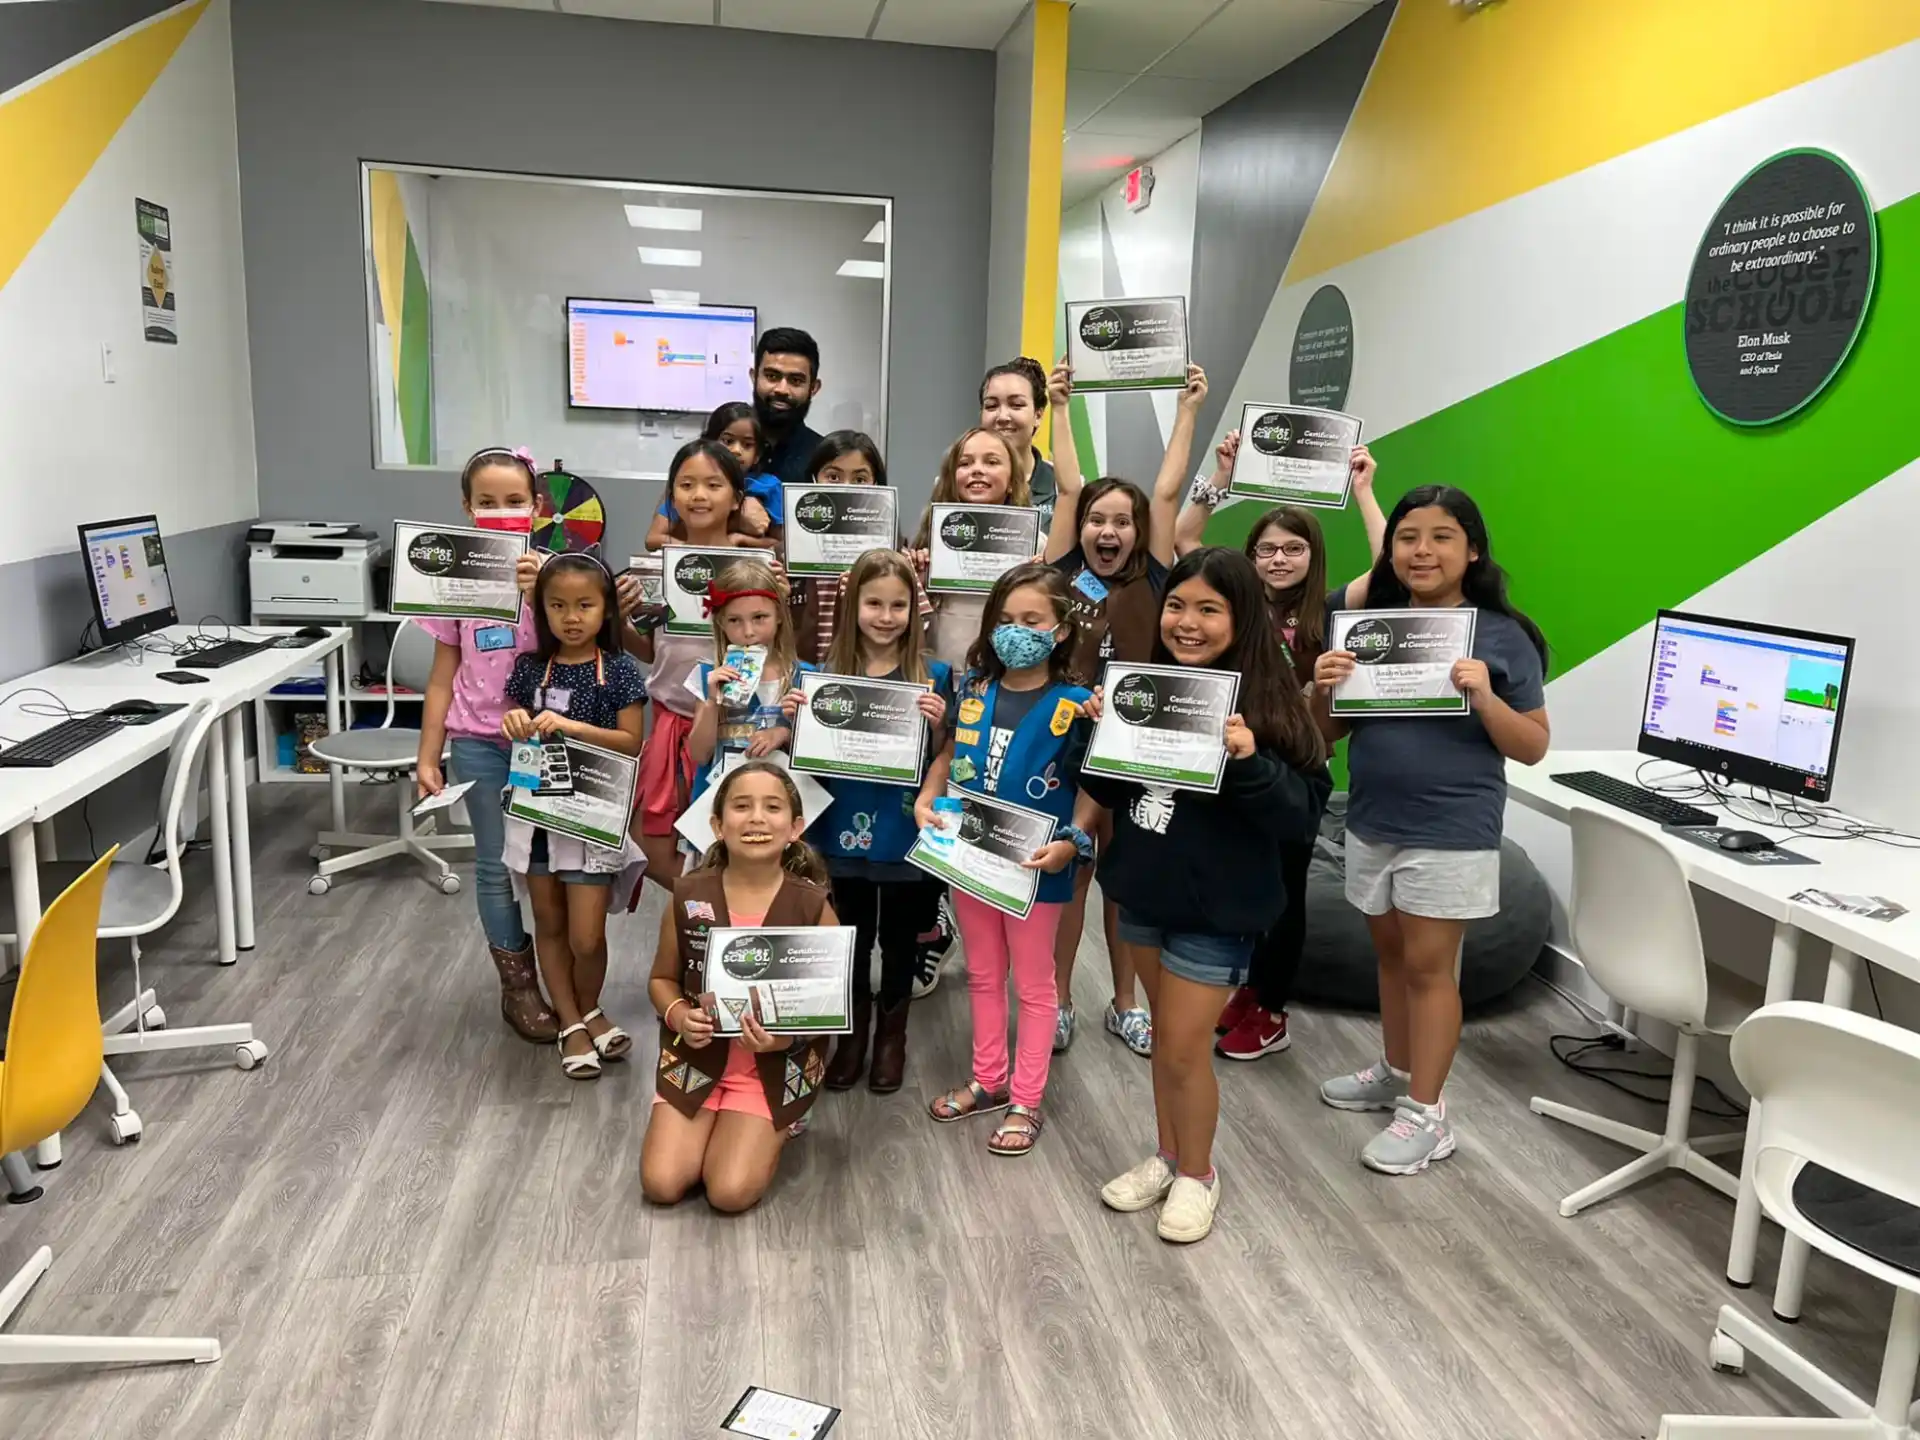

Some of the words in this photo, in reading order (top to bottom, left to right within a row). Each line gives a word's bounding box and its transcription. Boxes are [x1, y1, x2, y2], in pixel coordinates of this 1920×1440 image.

[1732, 219, 1758, 235] think
[1759, 216, 1769, 229] it
[1771, 213, 1780, 227] is
[1781, 203, 1825, 228] possible
[1825, 201, 1846, 220] for
[1709, 241, 1751, 258] ordinary
[1751, 233, 1785, 252] people
[1788, 229, 1799, 244] to
[1802, 225, 1840, 243] choose
[1843, 222, 1855, 235] to
[1730, 257, 1743, 273] be
[1707, 275, 1731, 294] the
[1737, 333, 1760, 347] Elon
[1762, 332, 1791, 346] Musk
[1740, 352, 1756, 362] CEO
[1765, 351, 1782, 361] Tesla
[1740, 366, 1753, 375] and
[1753, 364, 1780, 376] SpaceX
[1304, 430, 1339, 440] Certificate
[989, 526, 1021, 534] Certificate
[468, 551, 506, 560] Certificate
[484, 635, 503, 647] Ava
[1169, 695, 1209, 706] Certificate
[869, 702, 906, 713] Certificate
[579, 764, 612, 779] Certificate
